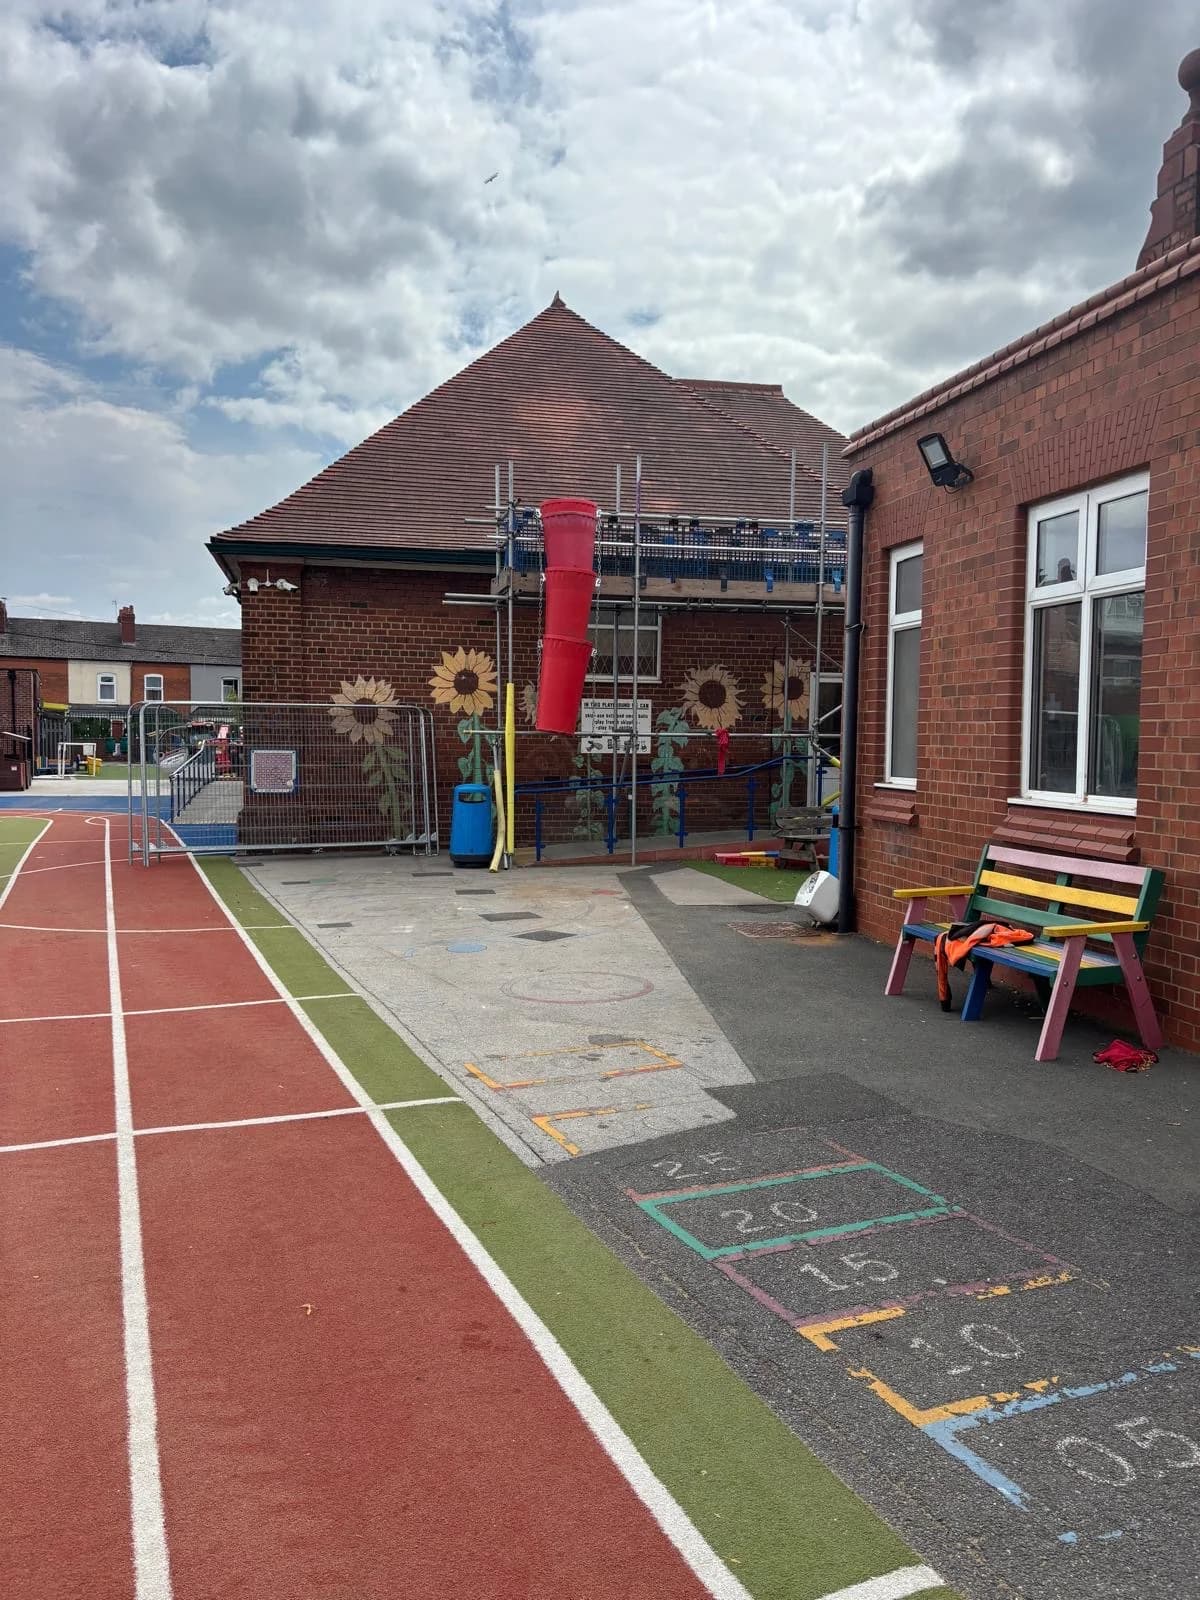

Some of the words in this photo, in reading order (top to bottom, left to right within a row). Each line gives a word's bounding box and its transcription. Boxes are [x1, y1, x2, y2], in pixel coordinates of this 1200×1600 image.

[652, 1151, 741, 1179] 25
[721, 1201, 818, 1234] 20
[800, 1251, 899, 1291] 15
[1055, 1416, 1200, 1487] 05
